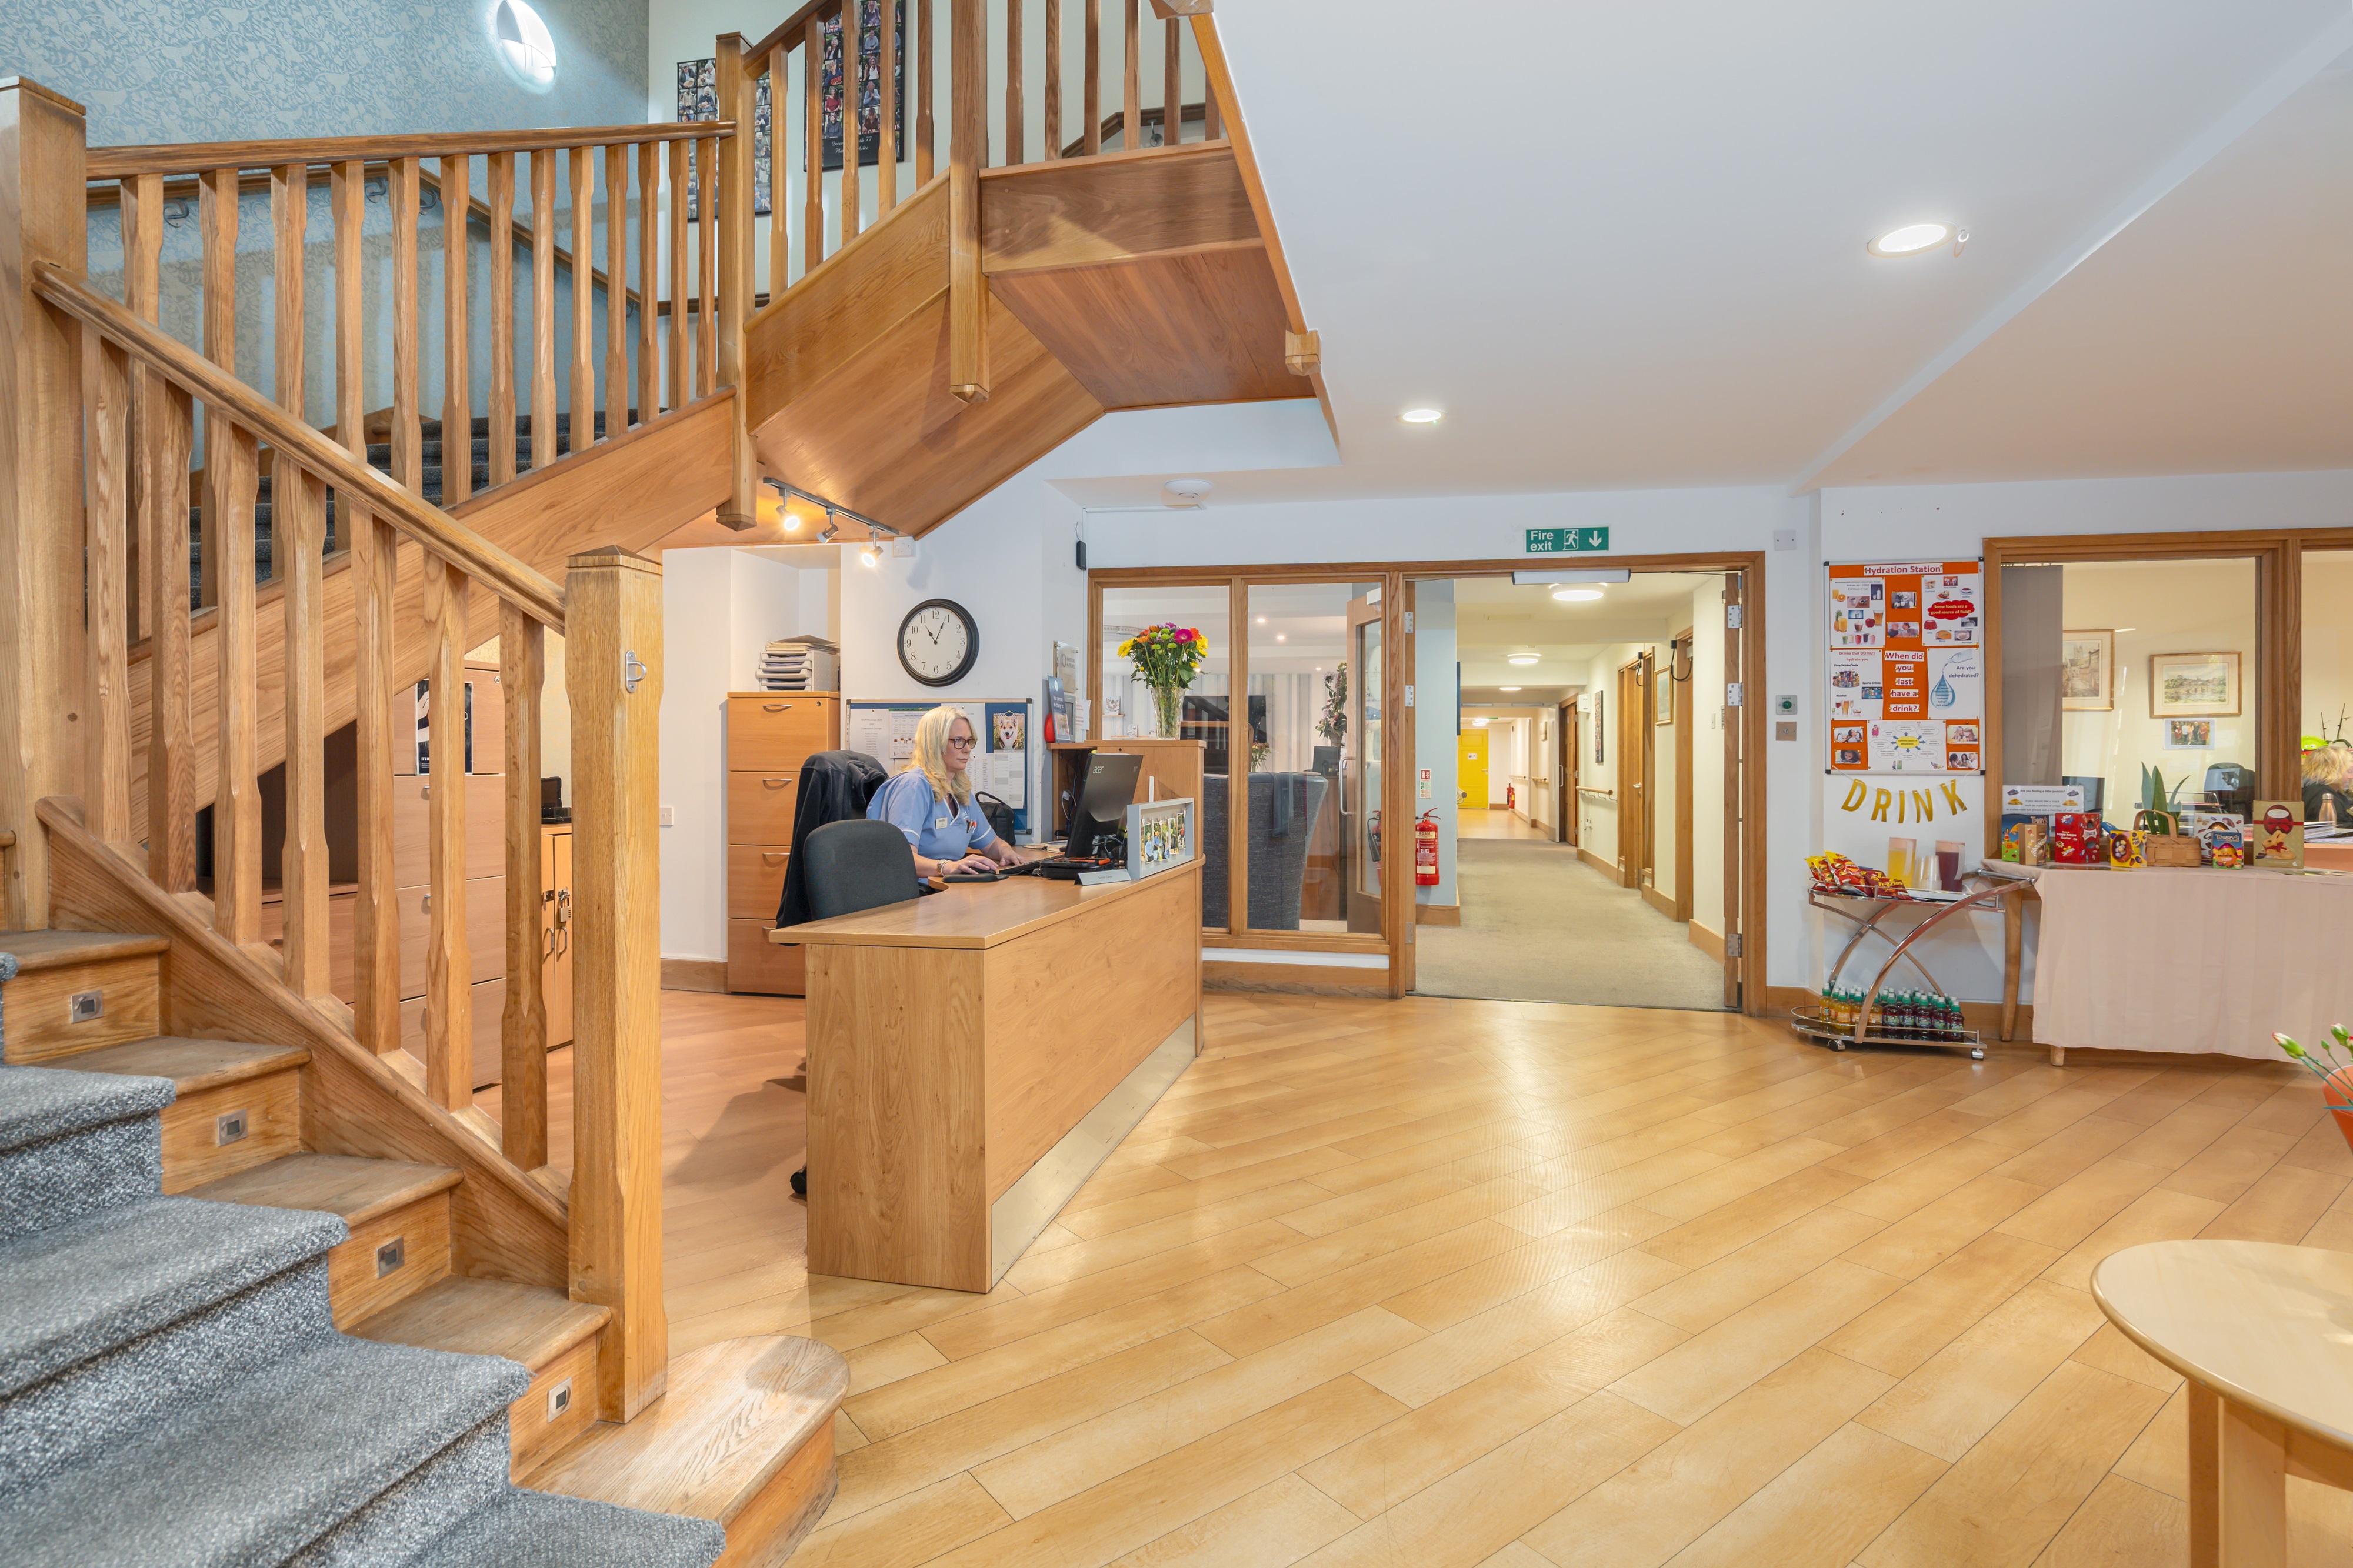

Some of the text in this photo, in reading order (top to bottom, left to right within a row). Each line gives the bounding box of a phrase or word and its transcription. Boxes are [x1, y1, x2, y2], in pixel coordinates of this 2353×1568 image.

[1531, 531, 1554, 541] Fire
[1530, 541, 1552, 551] exit
[1865, 566, 1908, 575] Hydration
[921, 615, 926, 623] 11
[932, 610, 939, 619] 12
[948, 614, 950, 623] 1
[911, 625, 919, 635] 10
[956, 624, 961, 633] 2
[906, 639, 911, 648] 9
[960, 637, 965, 646] 3
[911, 652, 916, 660] 8
[956, 650, 961, 659] 4
[921, 661, 926, 670] 7
[934, 665, 939, 674] 6
[946, 661, 952, 670] 5
[1092, 766, 1104, 774] acer
[1841, 778, 1968, 824] DRINK
